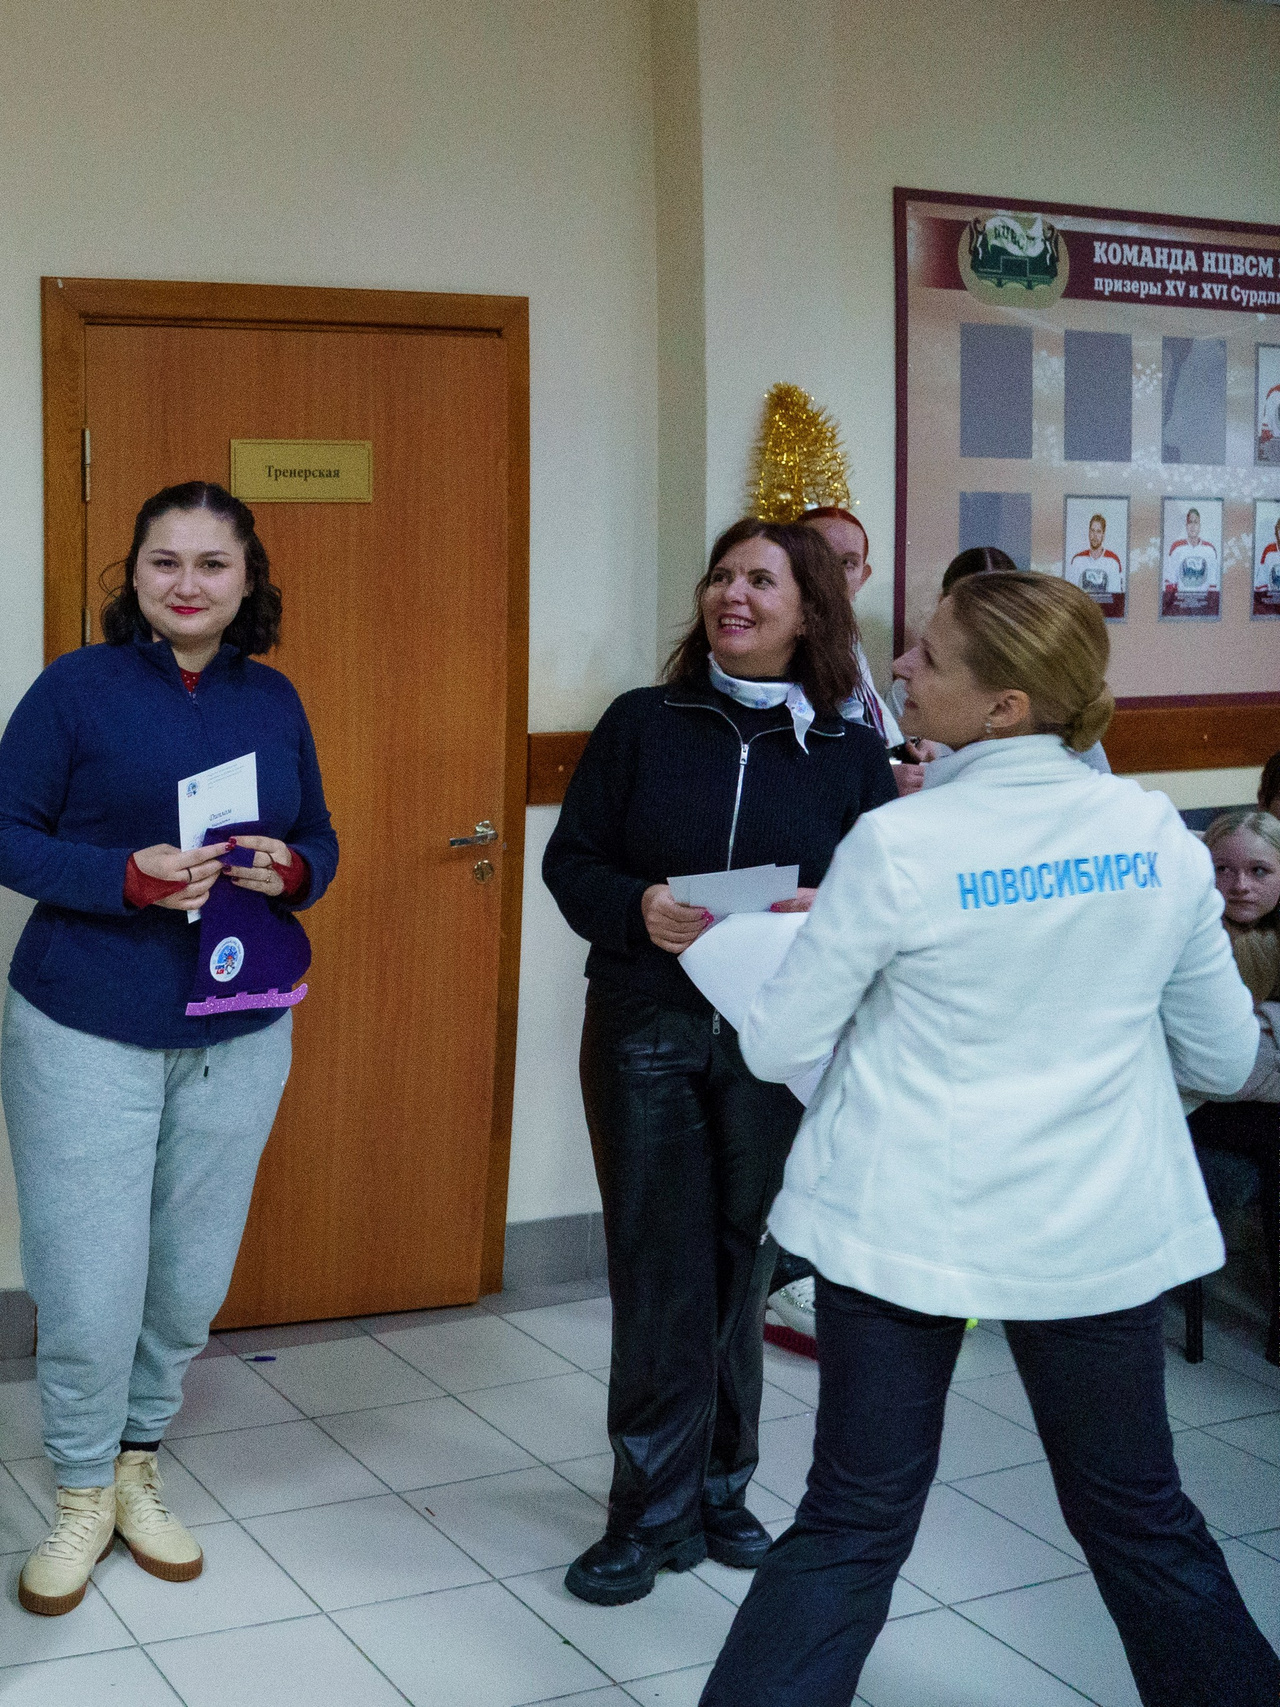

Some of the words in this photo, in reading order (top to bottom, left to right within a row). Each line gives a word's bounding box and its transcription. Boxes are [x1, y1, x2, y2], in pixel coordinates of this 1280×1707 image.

[1093, 240, 1198, 275] КОМАНДА
[1202, 251, 1274, 279] НЦВСМ
[1093, 277, 1162, 298] призеры
[1189, 284, 1199, 298] и
[264, 464, 340, 481] Тренерская
[957, 851, 1162, 910] НОВОСИБИРСК
